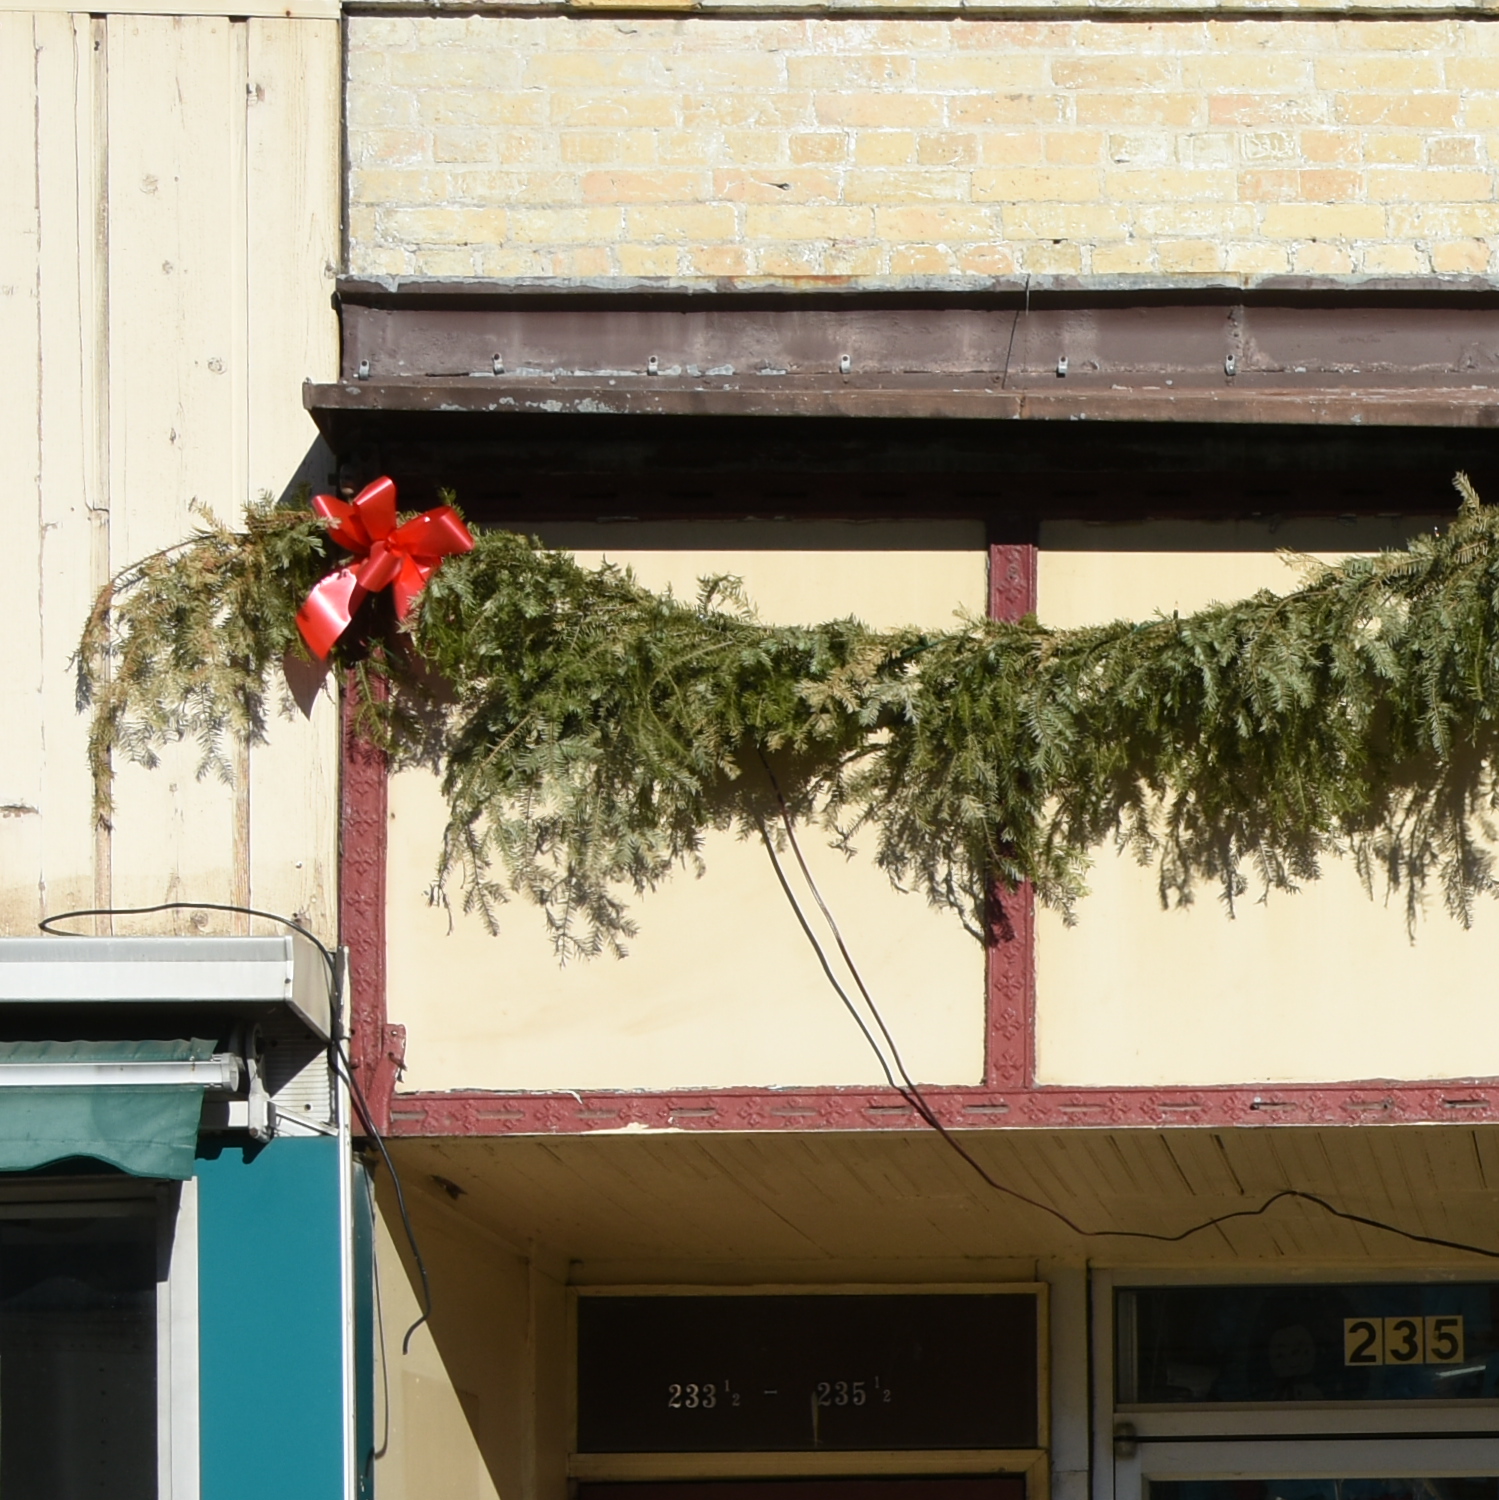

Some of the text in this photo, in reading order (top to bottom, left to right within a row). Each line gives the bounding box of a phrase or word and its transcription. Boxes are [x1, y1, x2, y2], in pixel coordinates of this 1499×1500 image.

[1350, 1318, 1460, 1361] 235
[668, 1384, 717, 1408] 233
[817, 1381, 866, 1406] 235
